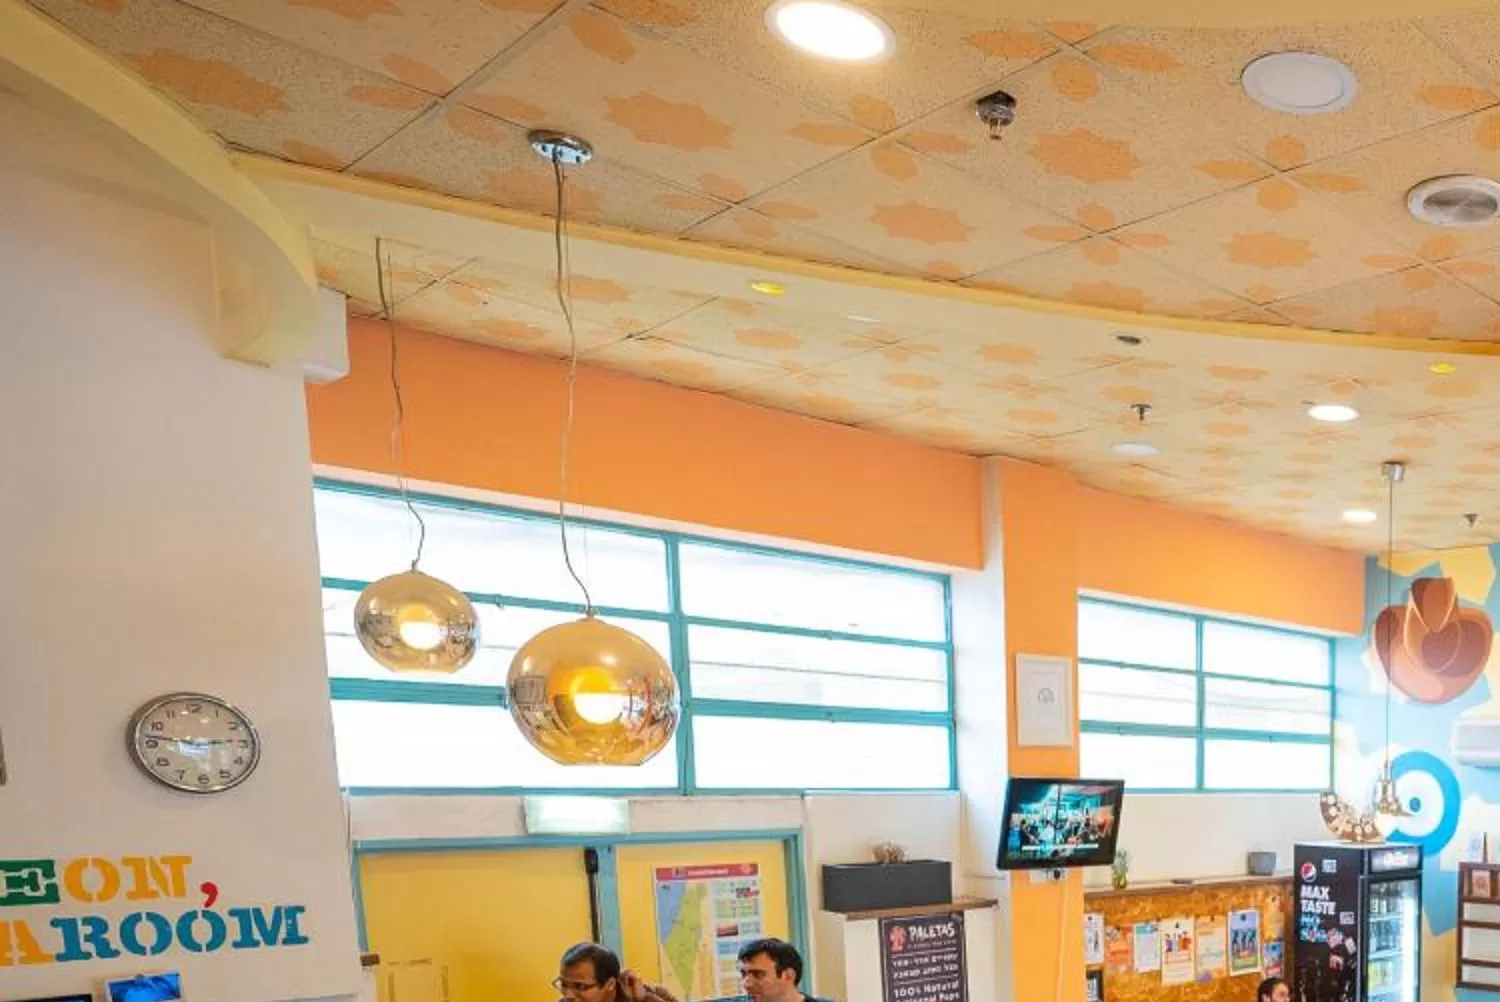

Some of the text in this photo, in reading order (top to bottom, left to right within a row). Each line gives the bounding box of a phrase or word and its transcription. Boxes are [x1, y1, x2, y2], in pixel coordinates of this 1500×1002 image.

[1301, 884, 1330, 900] MAX
[1300, 899, 1336, 915] TASTE
[908, 922, 956, 941] PALETAS
